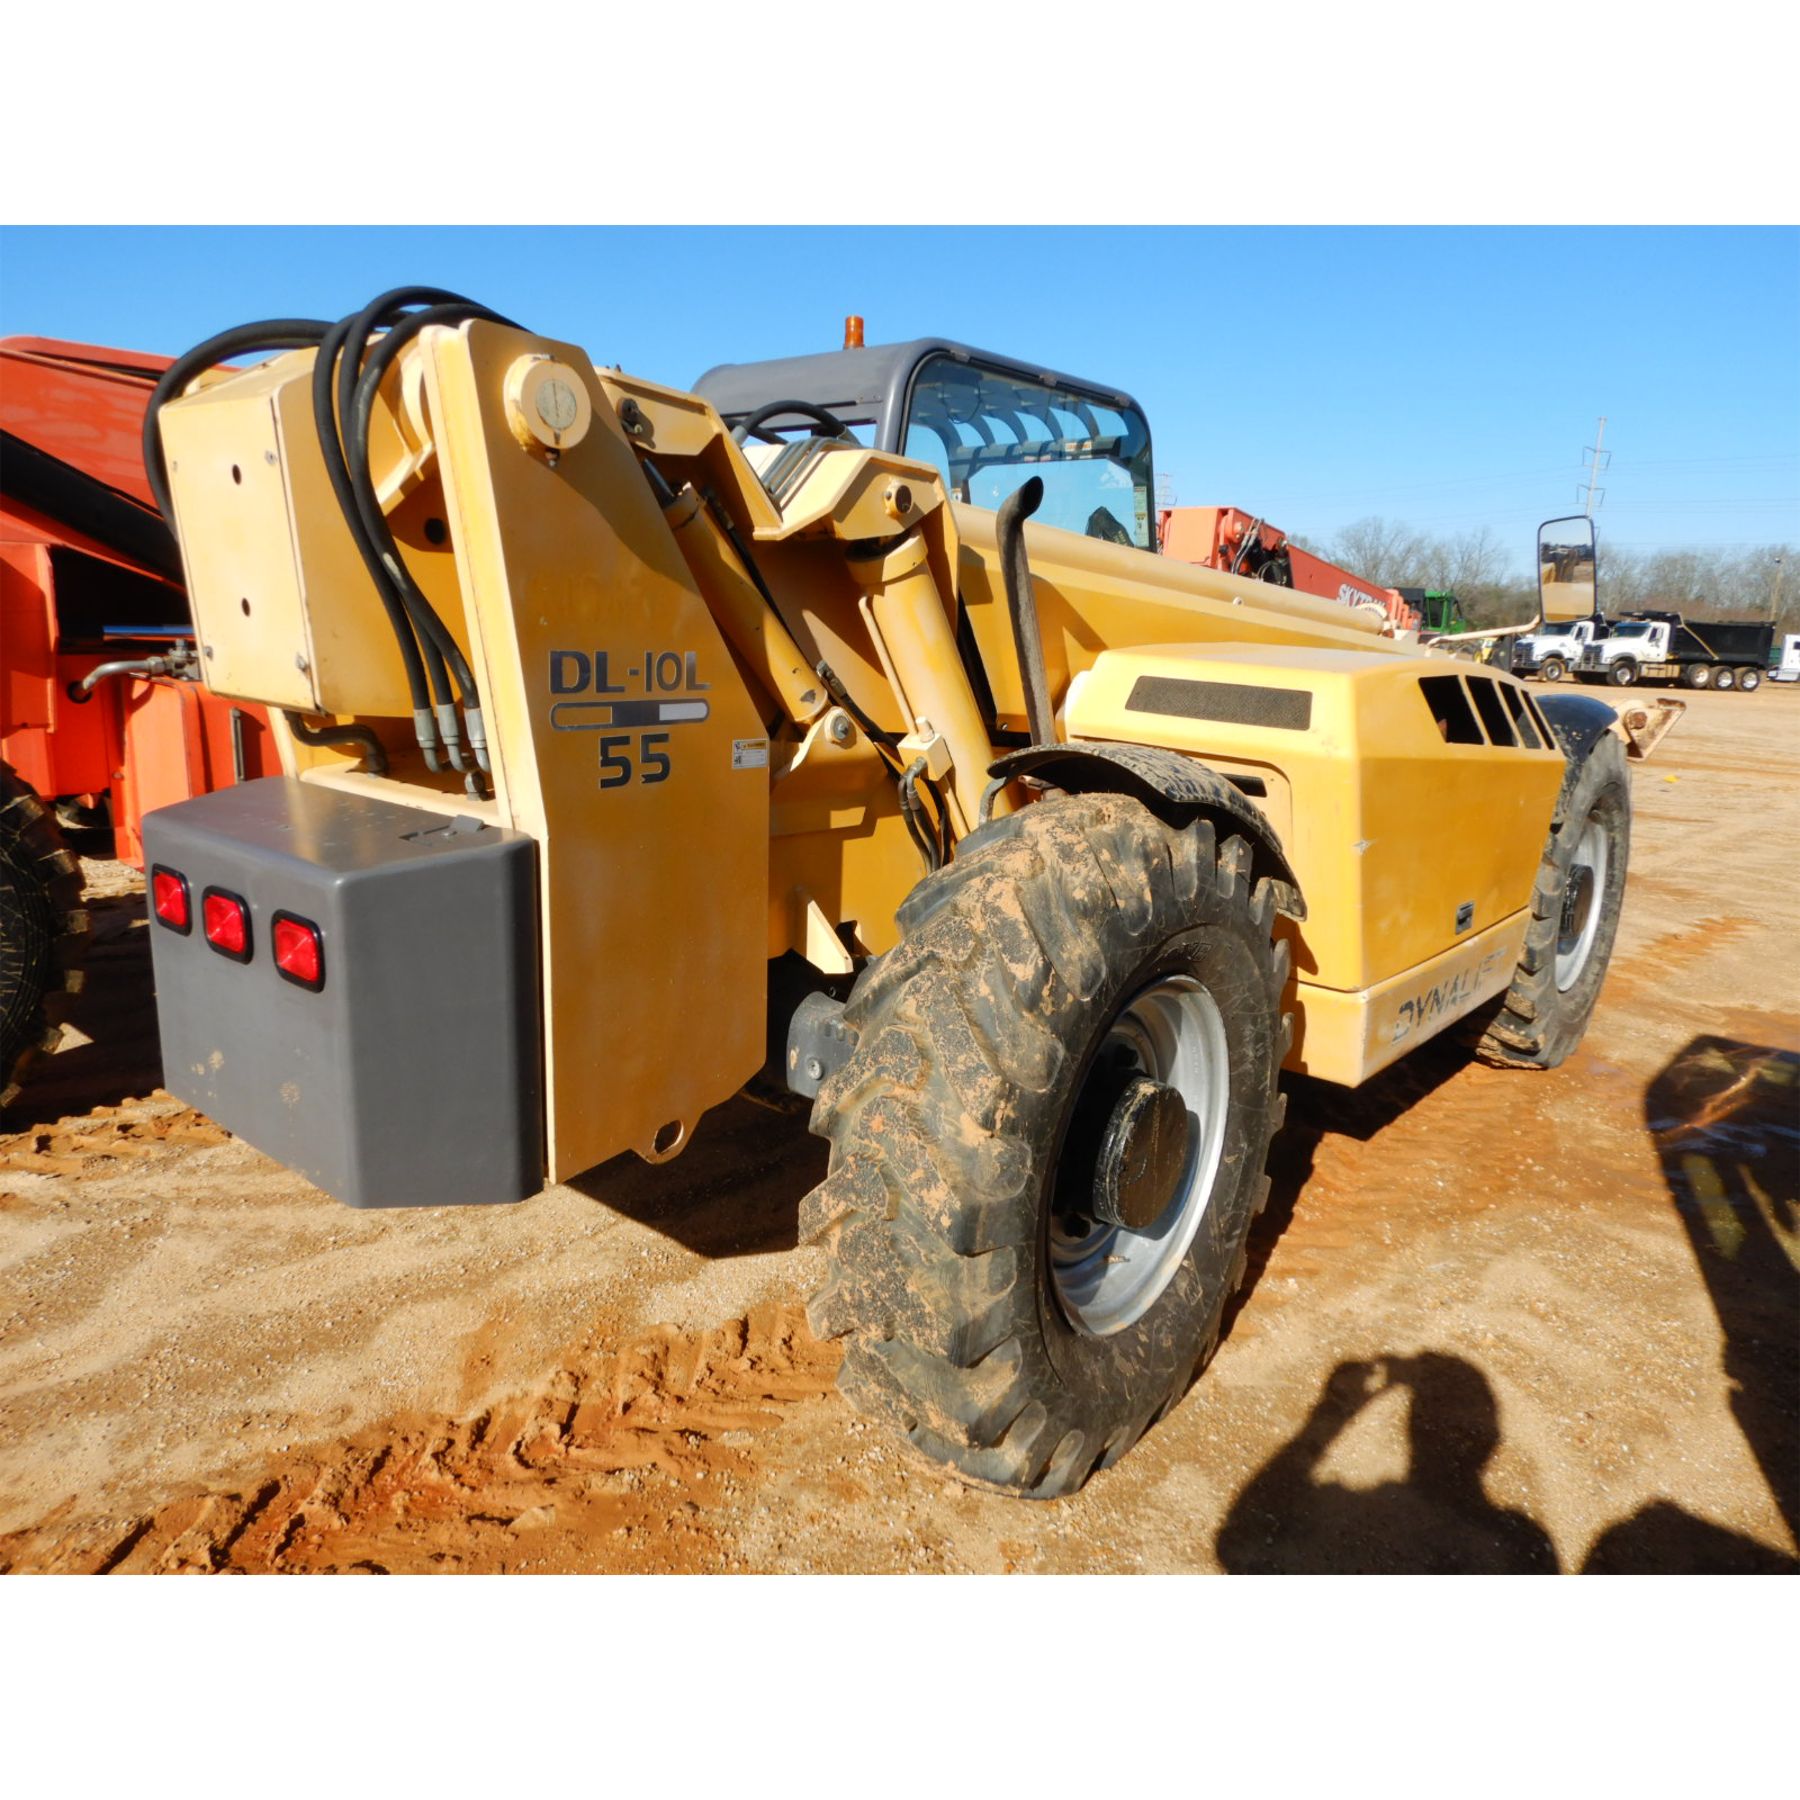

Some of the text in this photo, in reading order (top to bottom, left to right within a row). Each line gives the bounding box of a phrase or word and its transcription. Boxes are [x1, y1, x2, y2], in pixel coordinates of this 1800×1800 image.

[1338, 583, 1386, 607] SKYT
[550, 650, 711, 694] DL-10L
[600, 733, 670, 788] 55
